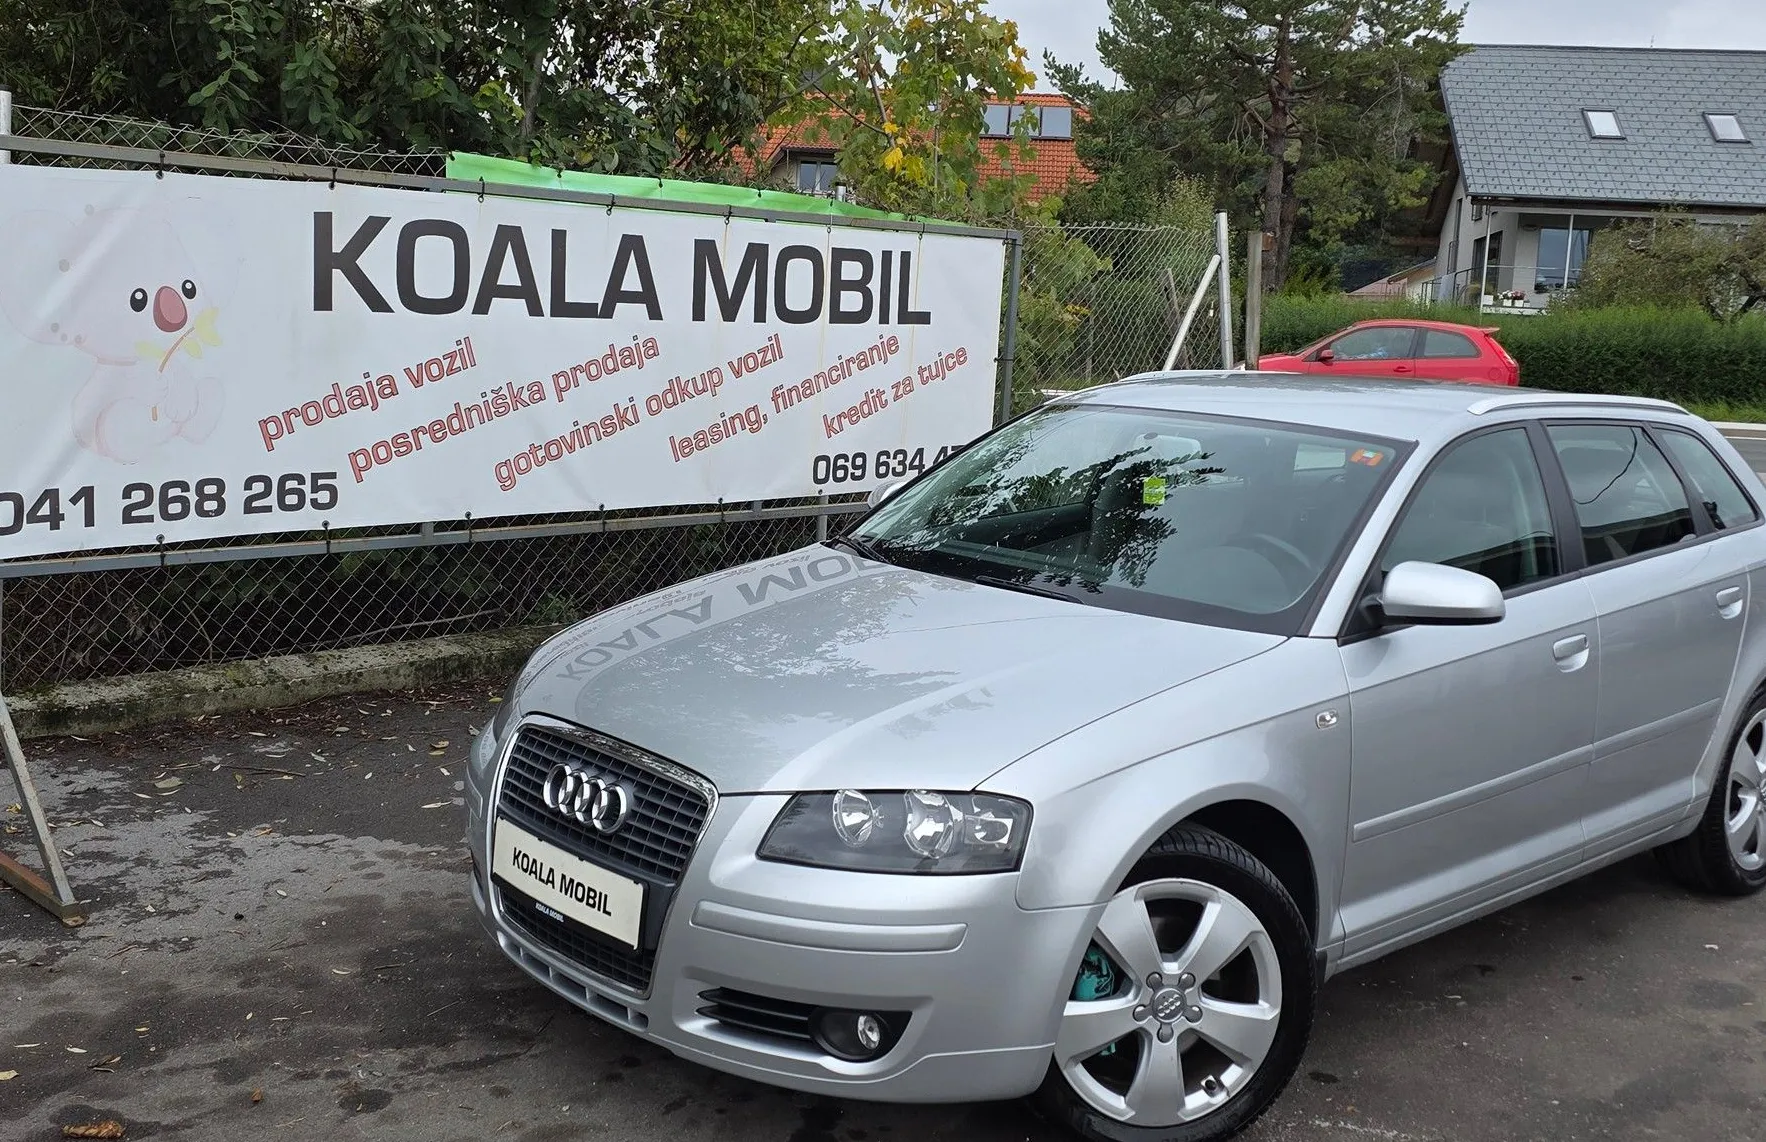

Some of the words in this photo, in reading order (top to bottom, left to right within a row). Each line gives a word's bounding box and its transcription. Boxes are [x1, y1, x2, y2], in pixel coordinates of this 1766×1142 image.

[314, 212, 663, 320] KOALA
[692, 239, 931, 324] MOBIL
[258, 372, 399, 452] prodaja
[404, 337, 476, 388] vozil
[348, 381, 546, 483] posredniška
[552, 335, 659, 402] prodaja
[495, 397, 639, 491] gotovinski
[646, 367, 723, 416] odkup
[728, 334, 783, 378] vozil
[670, 405, 767, 462] leasing,
[771, 335, 899, 413] financiranje
[823, 389, 887, 438] kredit
[892, 379, 914, 402] za
[918, 348, 967, 385] tujce
[0, 486, 94, 536] 041
[122, 478, 226, 524] 268
[244, 472, 338, 514] 265
[813, 452, 866, 484] 069
[875, 448, 925, 479] 634
[513, 847, 555, 889] KOALA
[560, 874, 611, 916] MOBIL
